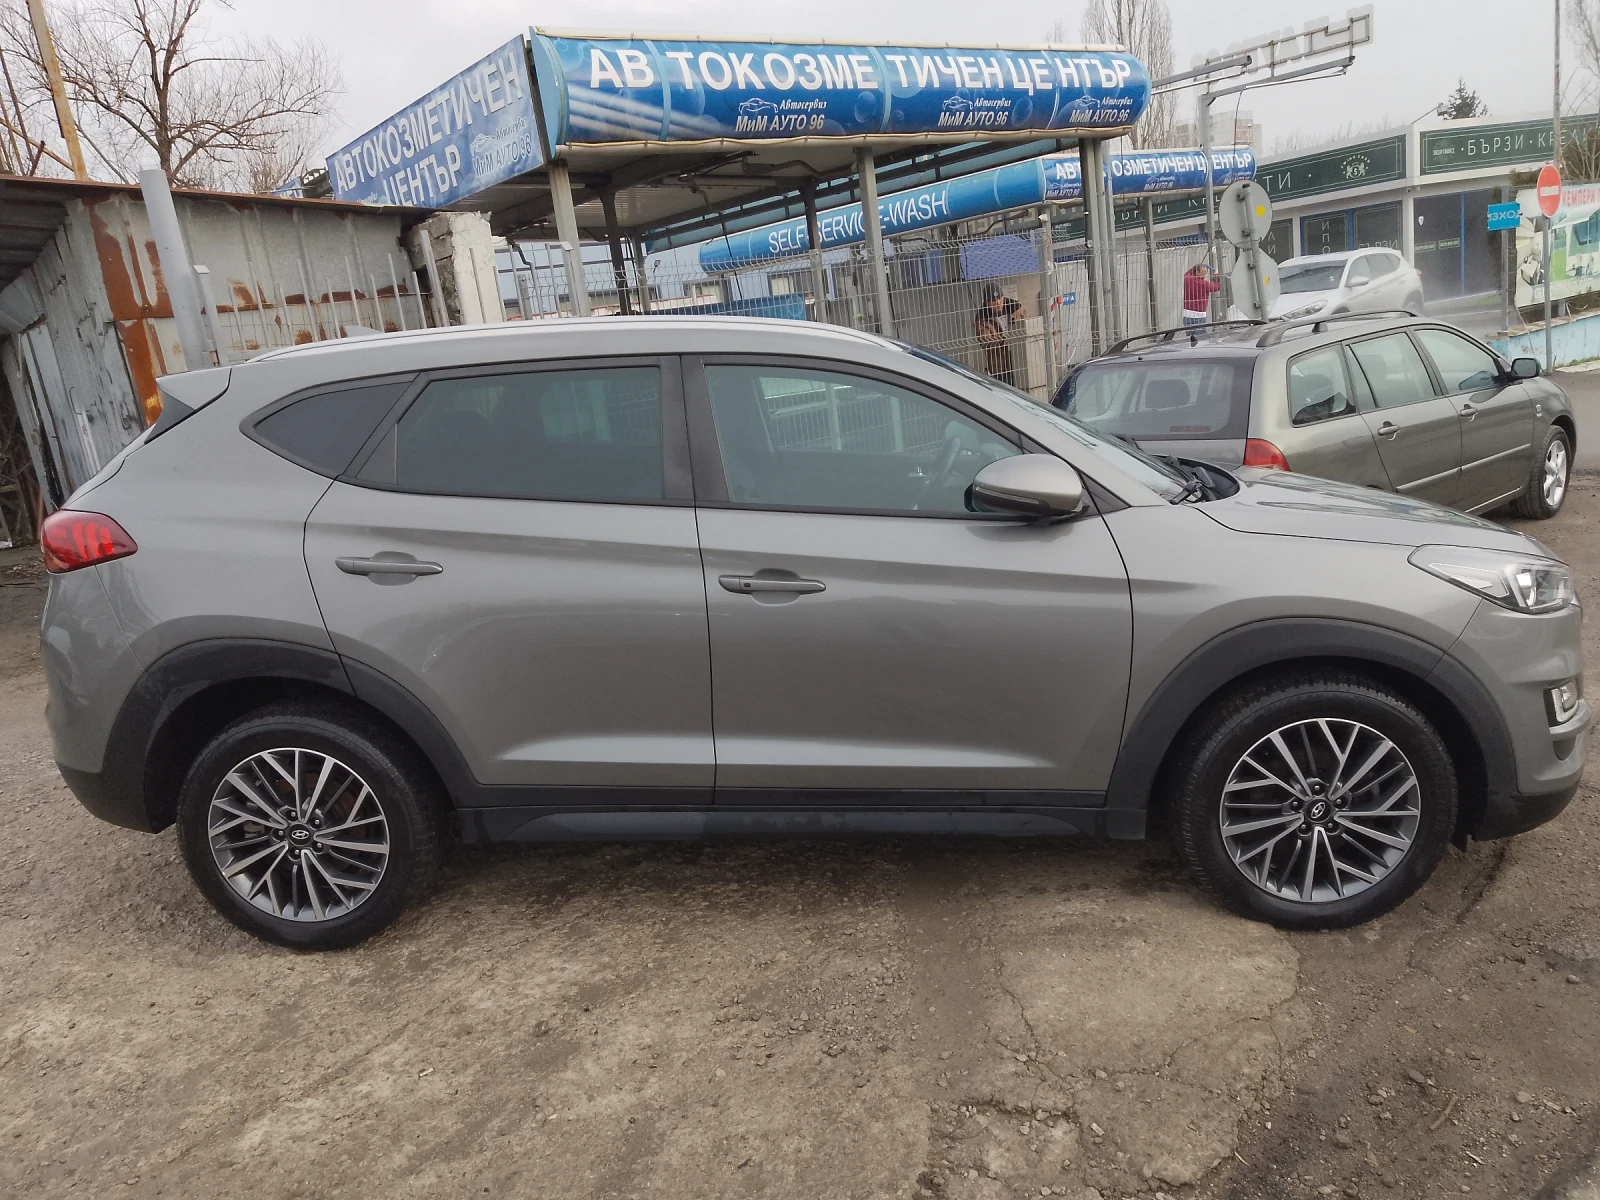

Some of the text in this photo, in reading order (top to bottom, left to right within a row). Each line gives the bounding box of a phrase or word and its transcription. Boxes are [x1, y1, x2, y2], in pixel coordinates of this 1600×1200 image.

[334, 51, 523, 195] АВТОКОЗМЕТИЧЕН
[769, 114, 806, 131] АУТО
[809, 114, 825, 130] 96
[964, 112, 994, 126] АУТО
[995, 111, 1009, 125] 96
[1091, 109, 1118, 122] АУТО
[1118, 108, 1130, 122] 96
[519, 134, 532, 157] 96
[1467, 134, 1524, 156] БЪРЗИ
[383, 144, 461, 206] ЦЕНТЪР
